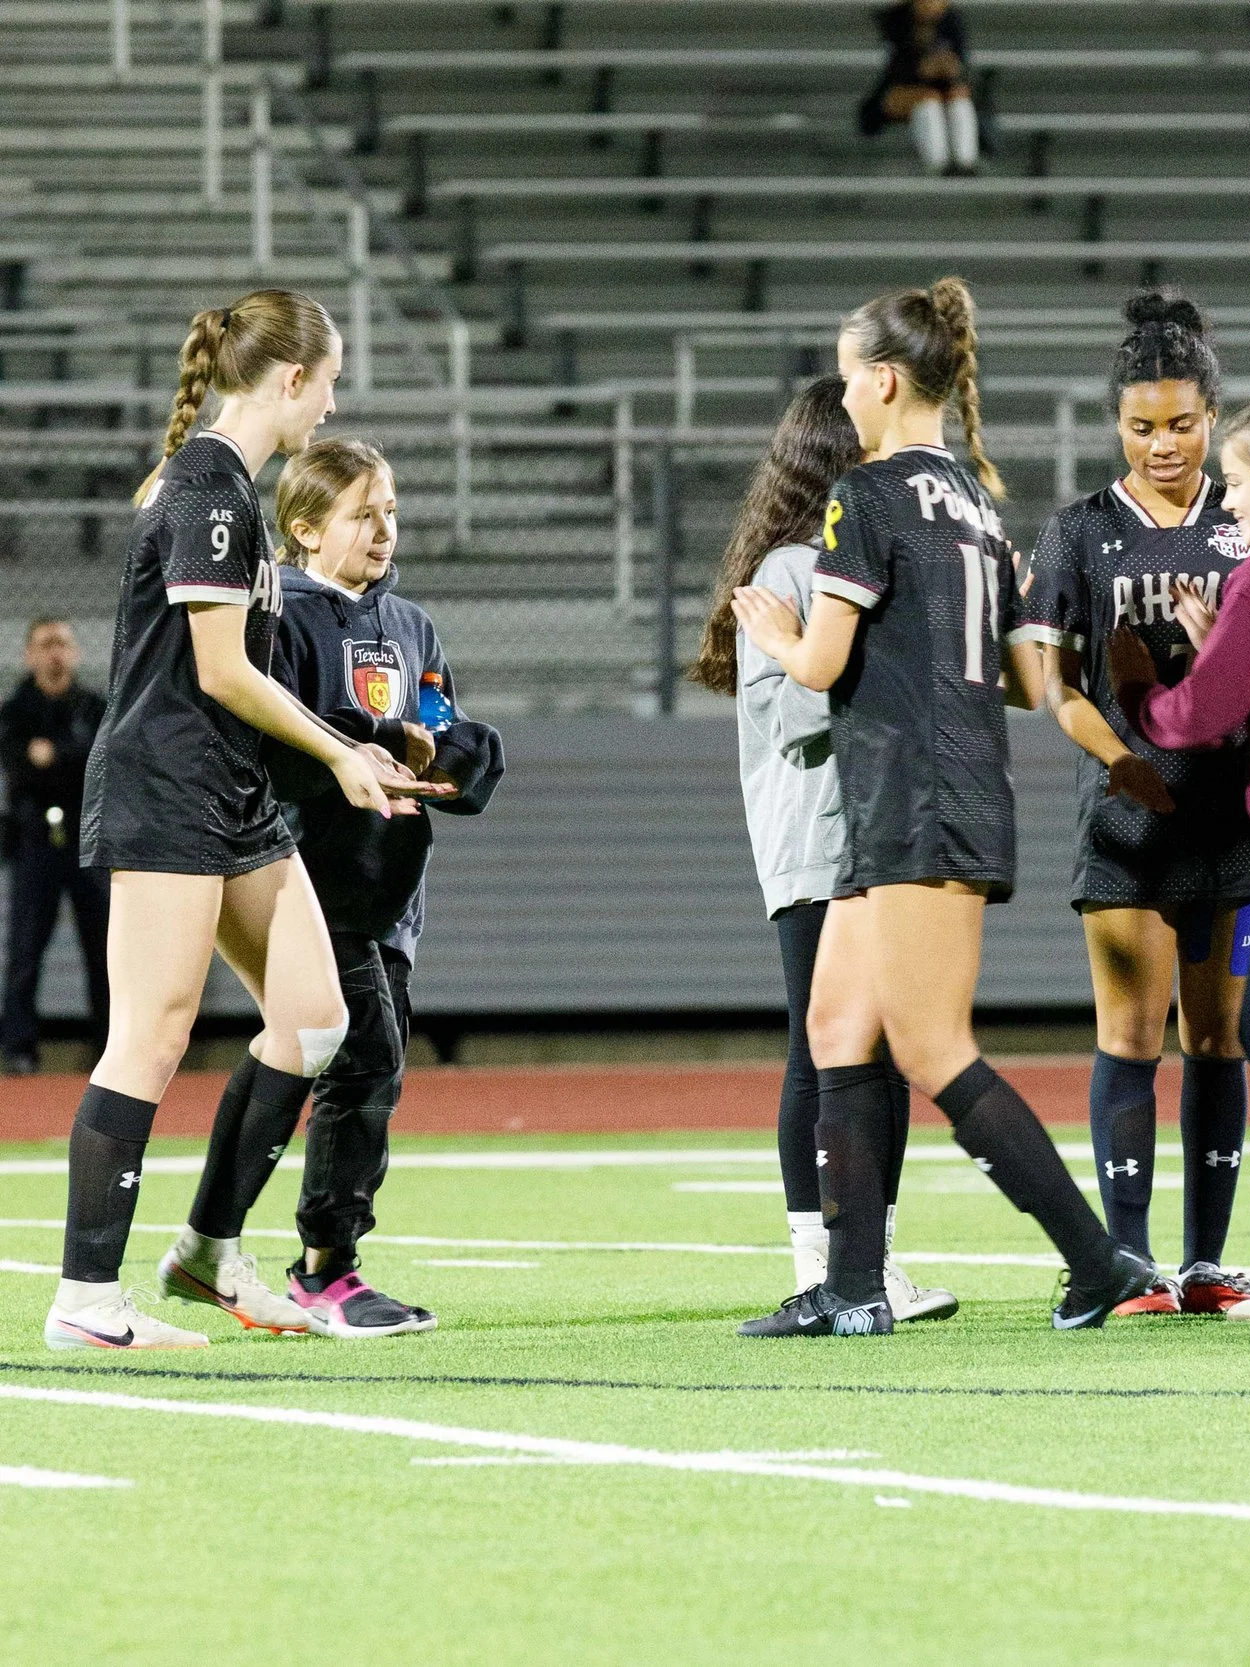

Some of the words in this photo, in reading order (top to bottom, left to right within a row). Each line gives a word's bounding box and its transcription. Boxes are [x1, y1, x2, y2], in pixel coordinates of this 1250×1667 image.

[208, 508, 234, 523] AJS
[210, 524, 230, 562] 9
[1113, 570, 1233, 630] AHM
